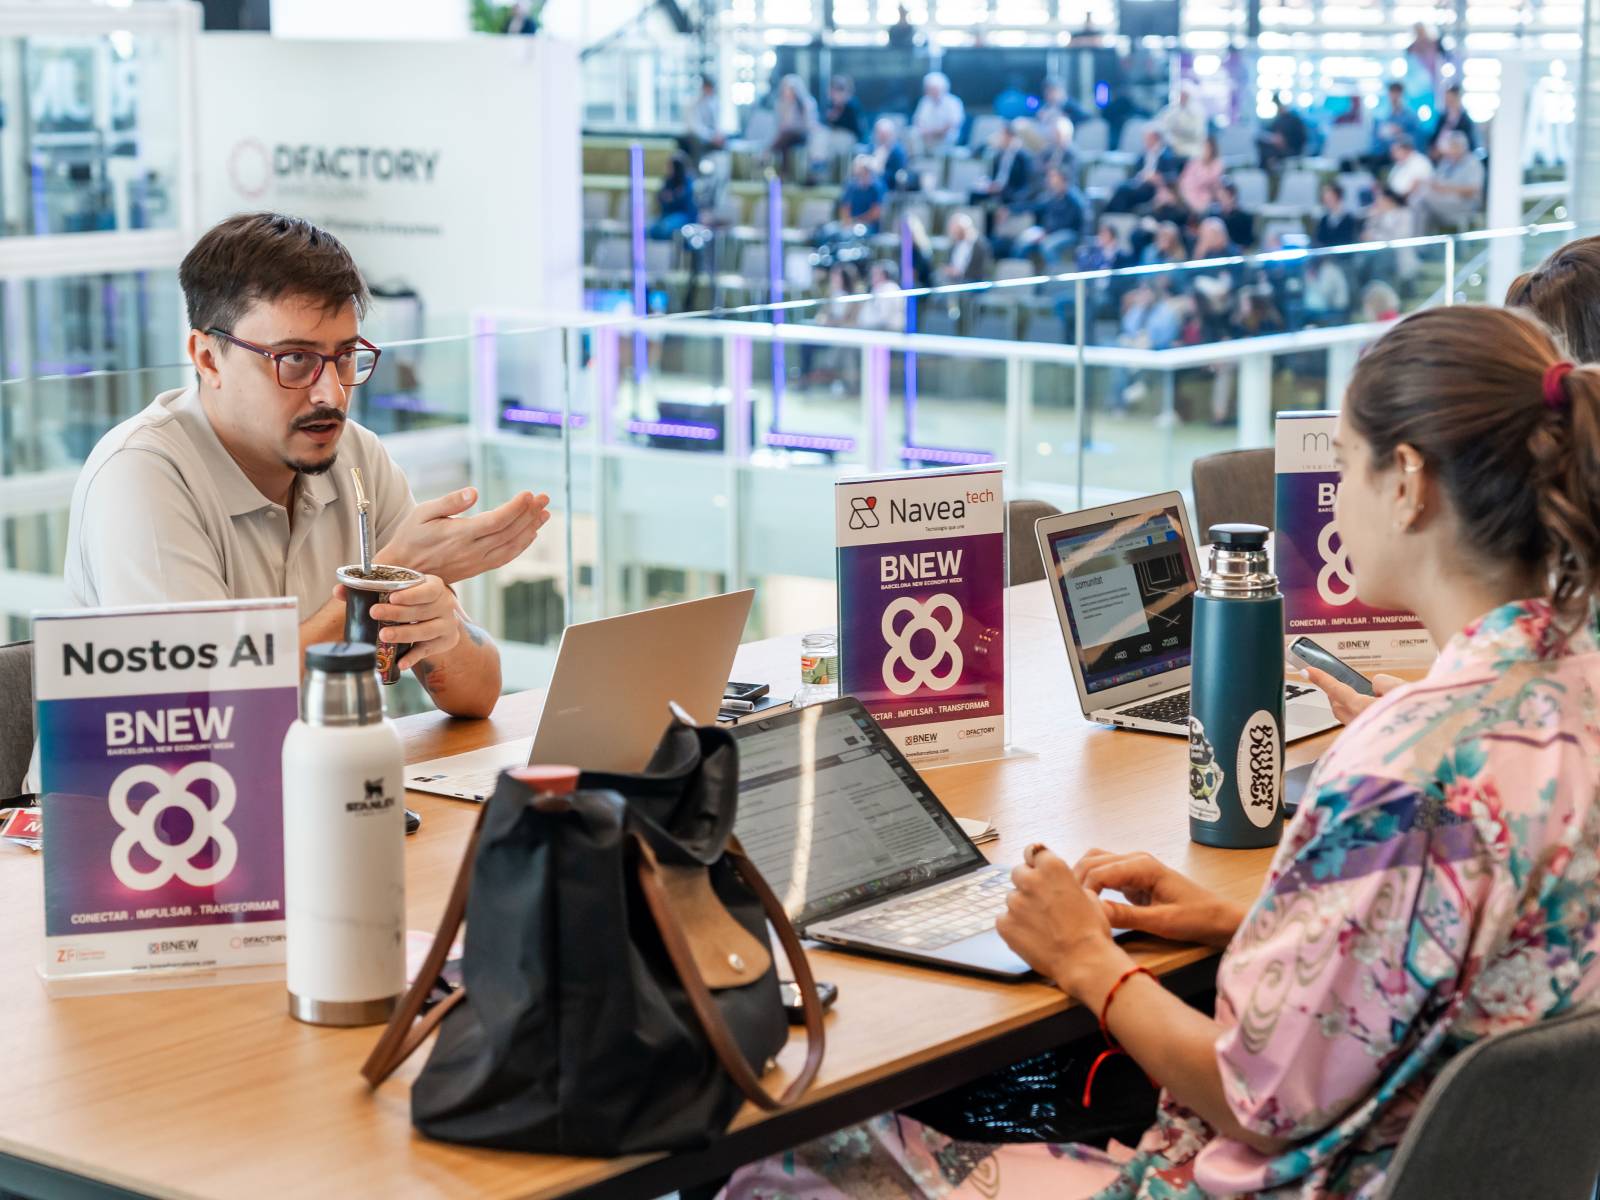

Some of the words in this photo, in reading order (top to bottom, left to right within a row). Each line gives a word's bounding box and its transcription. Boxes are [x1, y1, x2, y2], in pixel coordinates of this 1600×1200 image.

[273, 143, 440, 182] DFACTORY
[890, 498, 966, 524] Navea
[966, 489, 994, 504] tech
[880, 549, 963, 582] BNEW
[1289, 619, 1326, 627] CONECTAR
[1331, 617, 1367, 625] IMPULSAR
[1372, 615, 1419, 624] TRANSFORMA
[62, 640, 219, 676] Nostos
[229, 633, 275, 668] AI
[897, 707, 934, 718] IMPULSAR
[938, 700, 990, 713] TRANSFORMAR
[105, 706, 235, 746] BNEW
[912, 733, 938, 743] BNEW
[966, 727, 995, 736] DFACTORY
[71, 911, 129, 925] CONECTAR
[136, 906, 193, 920] IMPULSAR
[200, 900, 280, 915] TRANSFORMAR
[160, 939, 200, 952] BNEW
